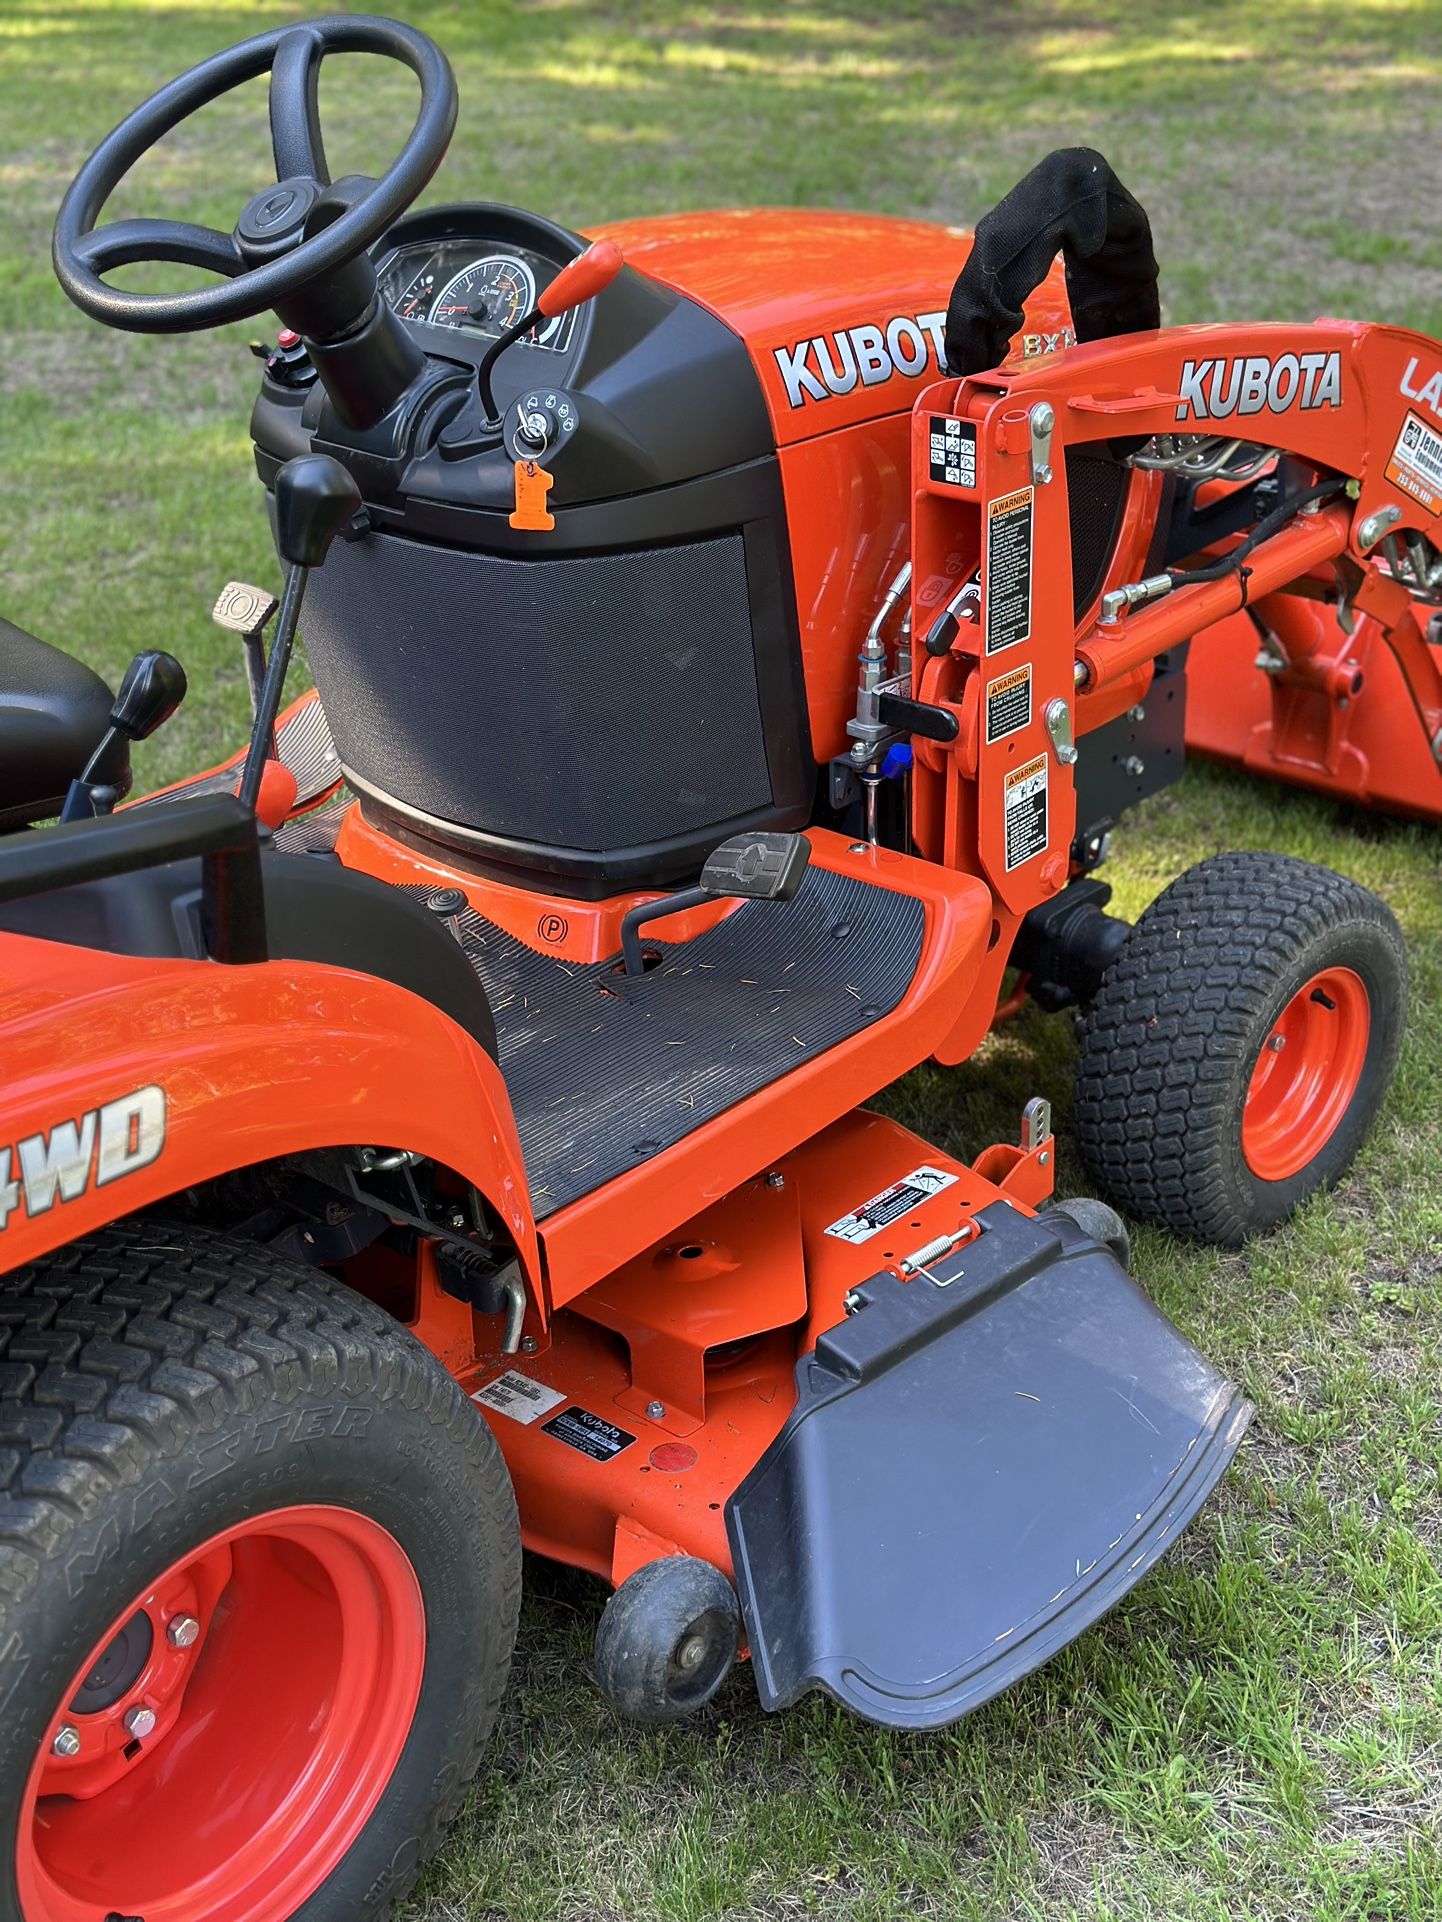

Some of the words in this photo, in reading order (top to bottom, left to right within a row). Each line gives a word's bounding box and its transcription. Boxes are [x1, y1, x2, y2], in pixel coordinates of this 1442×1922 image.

[491, 276, 500, 286] 2
[504, 291, 515, 301] 3
[1023, 328, 1078, 359] BX1
[773, 311, 949, 409] KUBOT
[1175, 350, 1342, 421] KUBOTA
[1400, 356, 1442, 418] LA
[998, 492, 1030, 512] WARNING
[996, 670, 1028, 691] WARNING
[1014, 759, 1045, 782] WARNING
[580, 1412, 621, 1439] Kubota
[66, 1405, 374, 1599] MASTER
